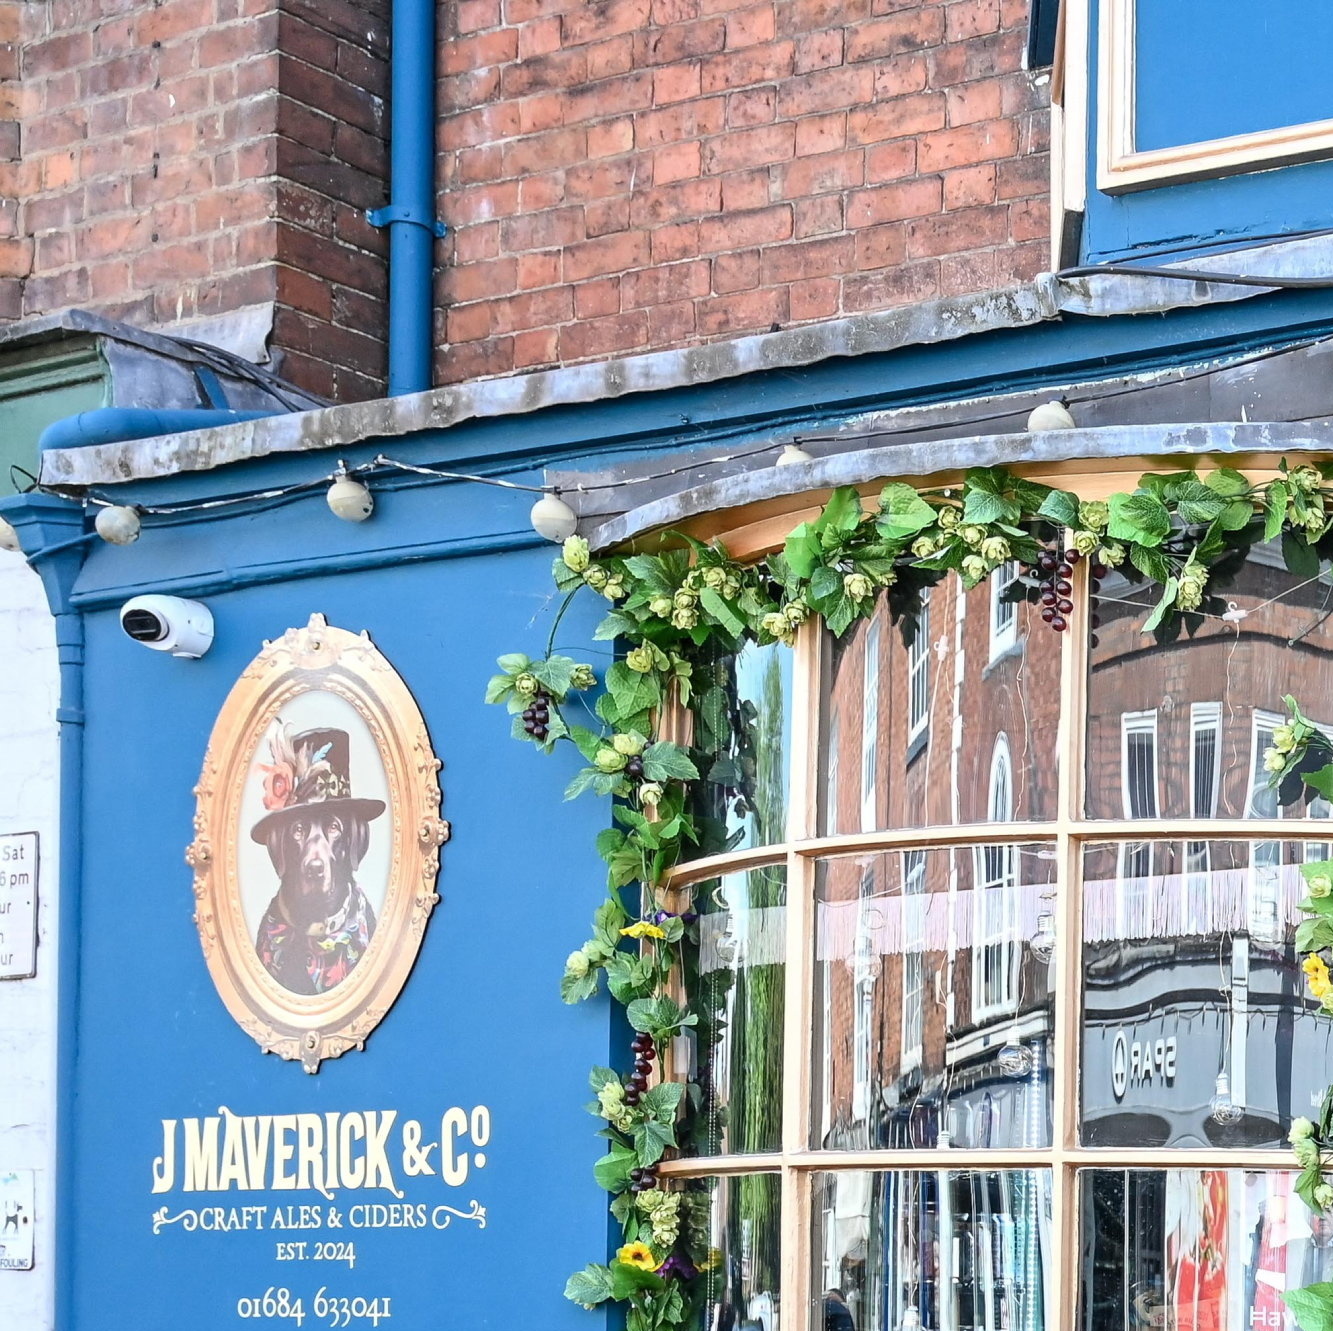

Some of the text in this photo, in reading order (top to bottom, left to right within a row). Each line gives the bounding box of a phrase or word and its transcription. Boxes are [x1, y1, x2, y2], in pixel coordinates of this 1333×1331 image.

[2, 844, 24, 861] Sat
[183, 1106, 404, 1200] MAVERICK
[403, 1121, 437, 1176] &
[199, 1204, 426, 1232] CRAFT ALES & CIDERS
[276, 1242, 356, 1268] EST. 2024
[238, 1287, 391, 1327] 01684 633041
